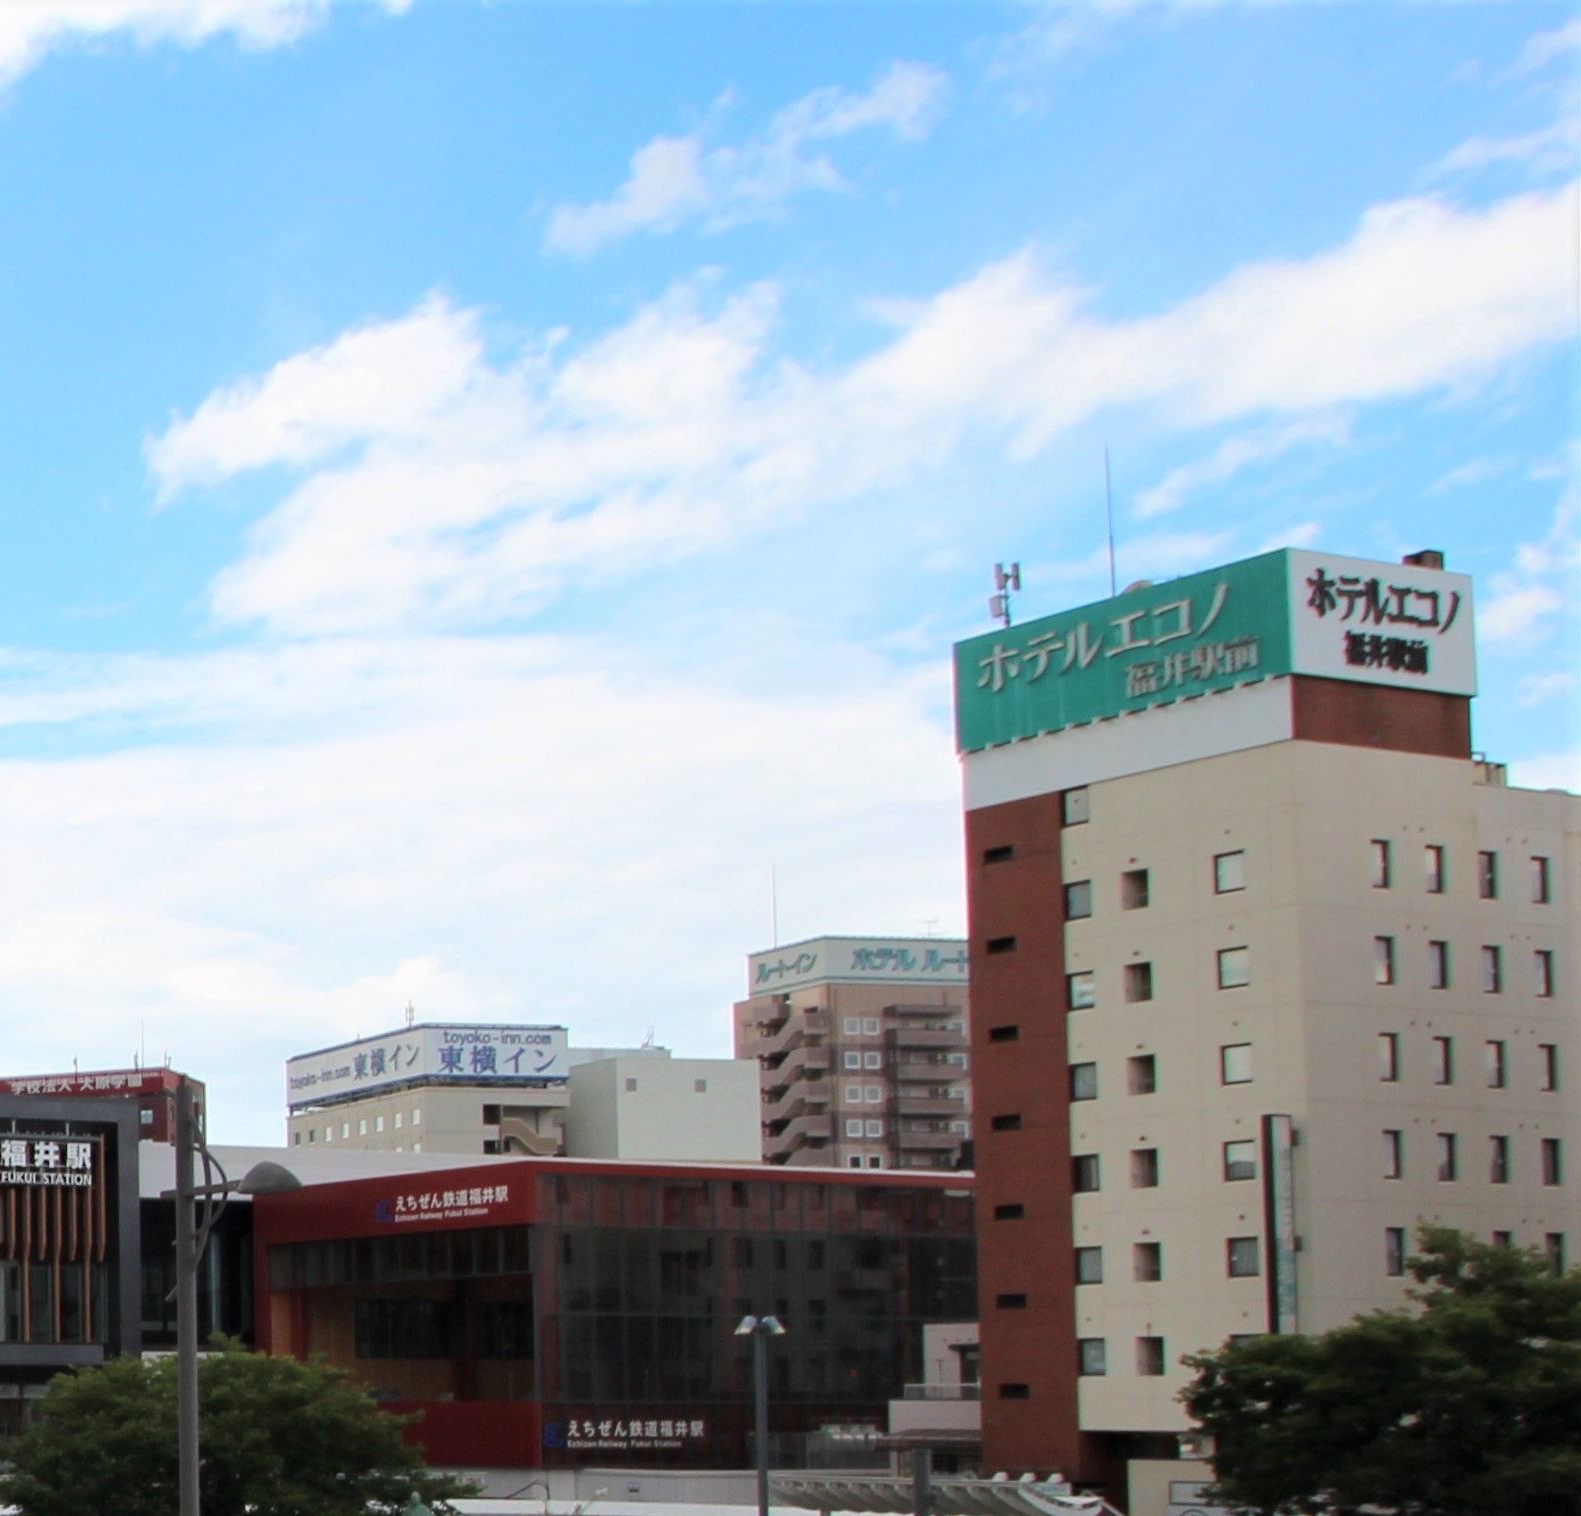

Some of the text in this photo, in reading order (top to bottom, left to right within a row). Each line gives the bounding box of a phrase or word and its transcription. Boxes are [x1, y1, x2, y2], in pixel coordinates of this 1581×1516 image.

[1306, 567, 1460, 635] ホテルエコノ
[976, 583, 1229, 692] ホテルエコノ
[1344, 630, 1429, 674] 福井駅前
[1127, 634, 1260, 698] 福井駅前
[756, 953, 818, 984] ルートイン
[851, 948, 915, 972] ホテル
[444, 1029, 552, 1046] toyoko-inn.com
[353, 1044, 420, 1082] 東横イン
[438, 1045, 557, 1075] 東横イン
[11, 1074, 142, 1095] 学校法人 大原学園
[0, 1139, 92, 1170] 福井駅
[1, 1172, 92, 1187] FUKUI STATION
[395, 1185, 509, 1212] えちぜん鉄道福井駅
[568, 1420, 705, 1438] えちぜん鉄道福井駅
[599, 1440, 627, 1449] Railway
[654, 1440, 681, 1448] Station
